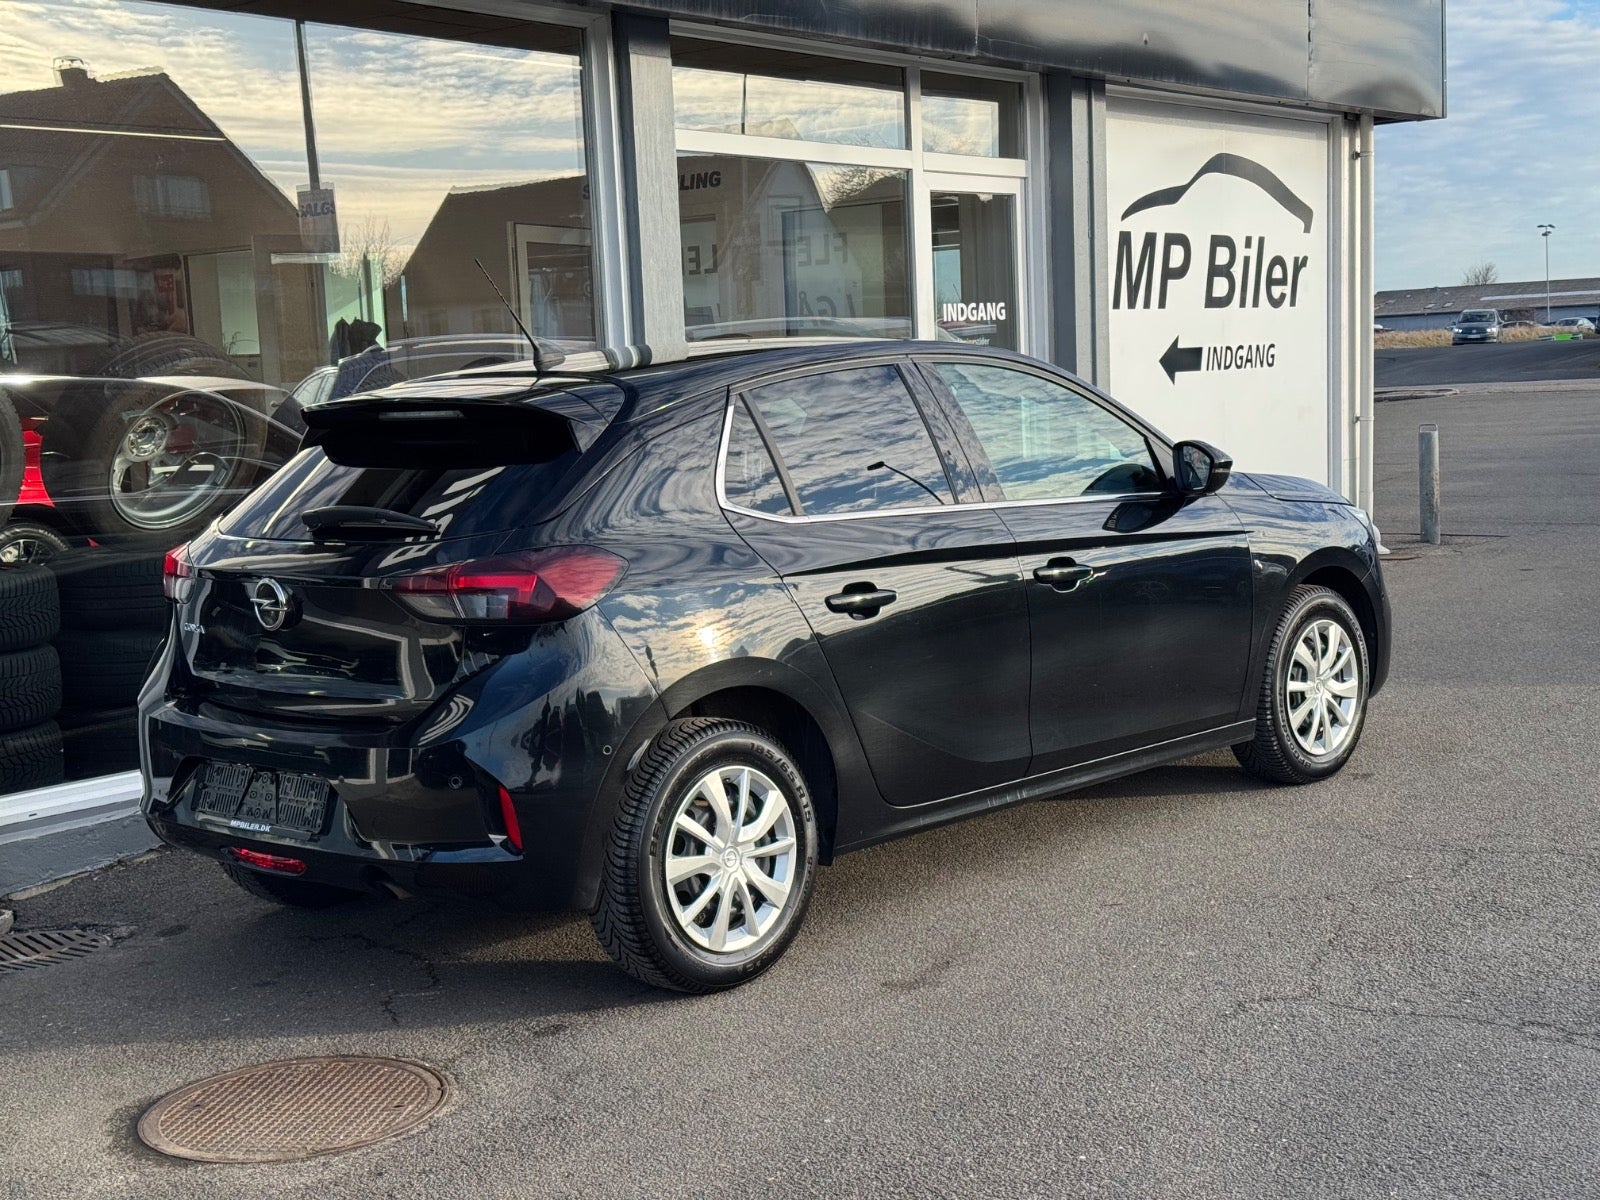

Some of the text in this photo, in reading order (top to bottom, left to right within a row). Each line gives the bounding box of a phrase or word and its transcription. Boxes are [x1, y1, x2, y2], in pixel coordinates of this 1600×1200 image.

[678, 171, 721, 191] LING
[1112, 231, 1309, 310] MP Biler
[943, 302, 1006, 322] INDGANG
[1206, 343, 1276, 371] INDGANG
[750, 742, 798, 783] 185/65
[230, 819, 271, 832] MPBILER.DK
